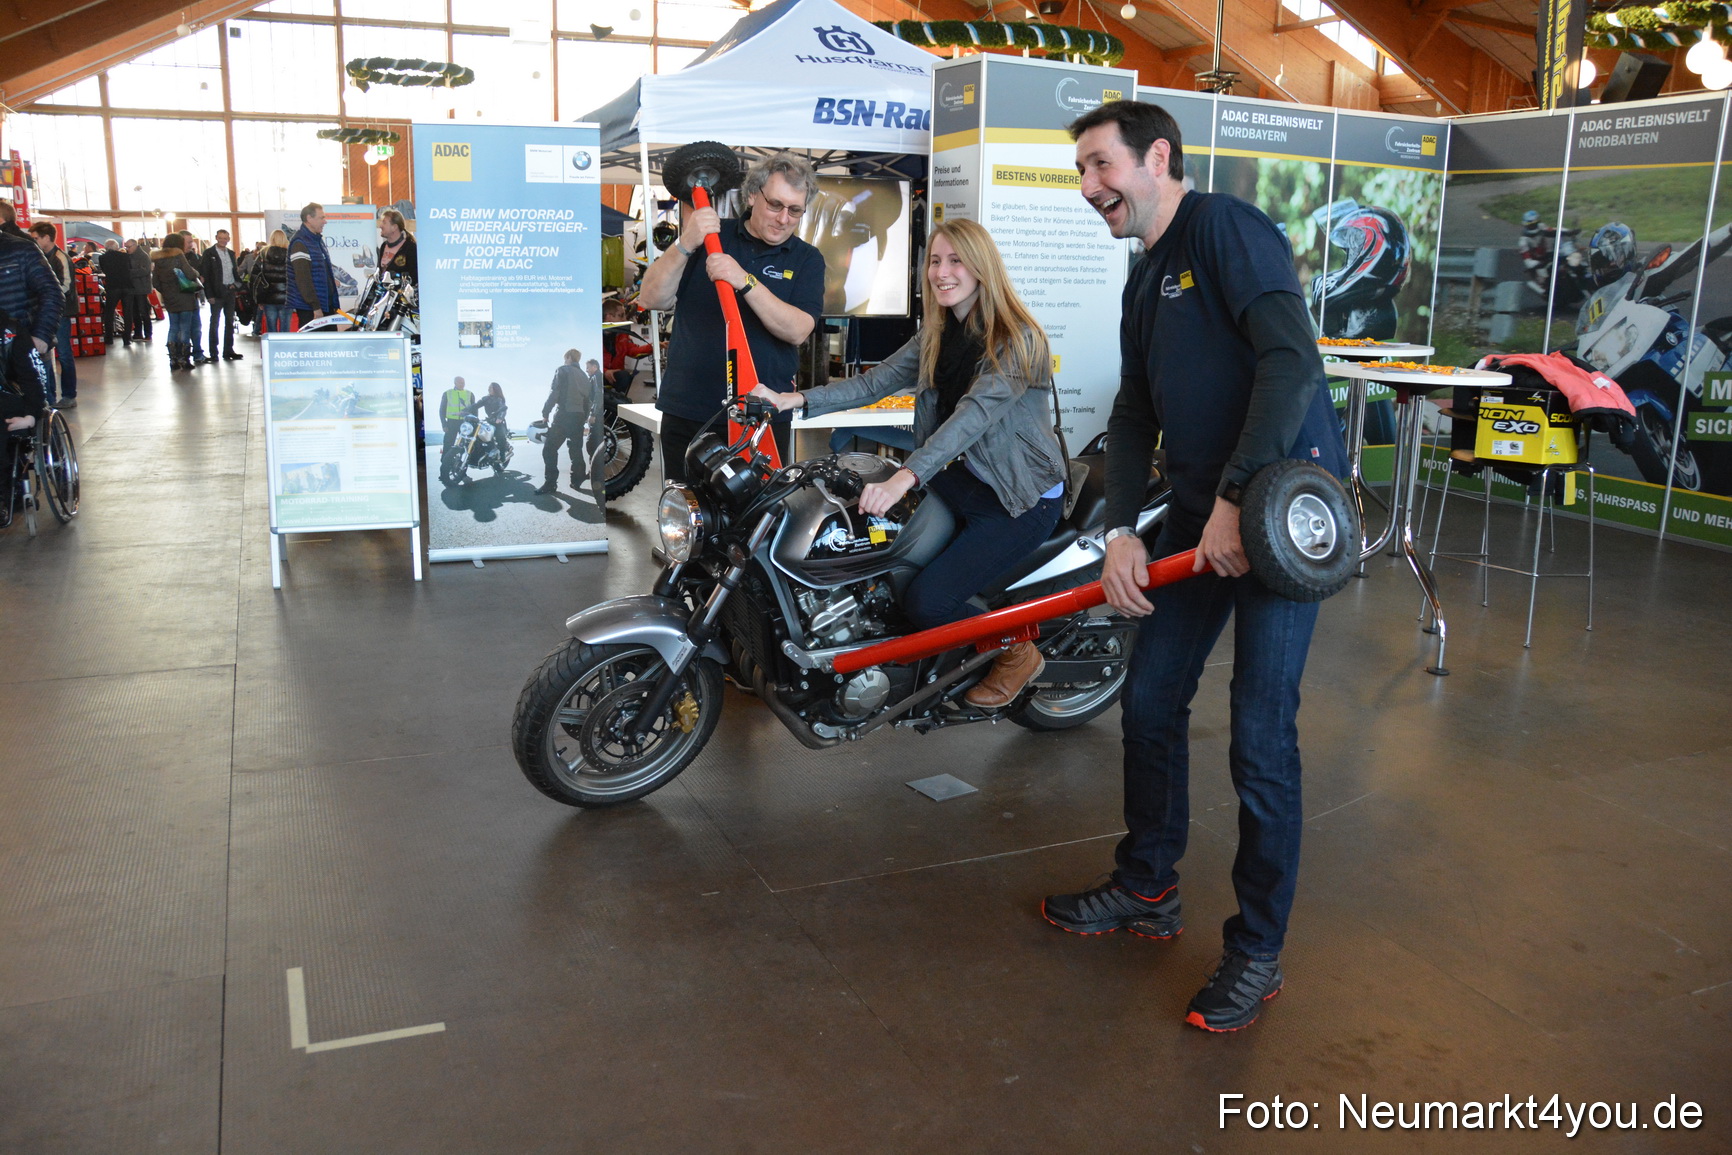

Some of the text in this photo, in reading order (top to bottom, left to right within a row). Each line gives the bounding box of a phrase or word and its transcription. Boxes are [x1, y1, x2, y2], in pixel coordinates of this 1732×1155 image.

[794, 54, 925, 74] Husqvarna
[1103, 90, 1121, 100] ADAC
[1221, 109, 1324, 131] ADAC ERLEBNISWELT
[1580, 108, 1711, 133] ADAC ERLEBNISWELT
[1220, 125, 1288, 143] NORDBAYERN
[1422, 136, 1436, 144] ADAC
[1578, 131, 1659, 149] NORDBAYERN
[434, 144, 470, 157] ADAC
[934, 164, 961, 174] Preise und
[996, 170, 1037, 182] BESTENS
[933, 178, 969, 187] Informationen
[1040, 204, 1052, 212] sind
[429, 208, 575, 220] DAS BMW MOTORRAD
[1053, 216, 1074, 224] Können
[1075, 217, 1086, 225] und
[1087, 218, 1106, 226] Wissen
[450, 220, 588, 233] WIEDERAUFSTEIGER-
[1016, 228, 1046, 237] Umgebung
[1070, 229, 1097, 238] Prüfstand!
[443, 233, 523, 245] TRAINING IN
[1013, 240, 1064, 250] Motorrad-Trainings
[465, 246, 560, 257] KOOPERATION
[1057, 253, 1105, 261] unterschiedlichen
[435, 258, 534, 270] MIT DEM ADAC
[1033, 265, 1079, 273] anspruchsvolles
[1039, 277, 1061, 285] steigern
[1022, 289, 1047, 297] Qualität.
[273, 351, 298, 359] ADAC
[299, 350, 360, 358] ERLEBNISWELT
[280, 494, 370, 505] MOTORRAD-TRAINING
[1592, 491, 1657, 514] FAHRSPASS
[1672, 507, 1700, 522] UND
[869, 525, 885, 534] ADAC
